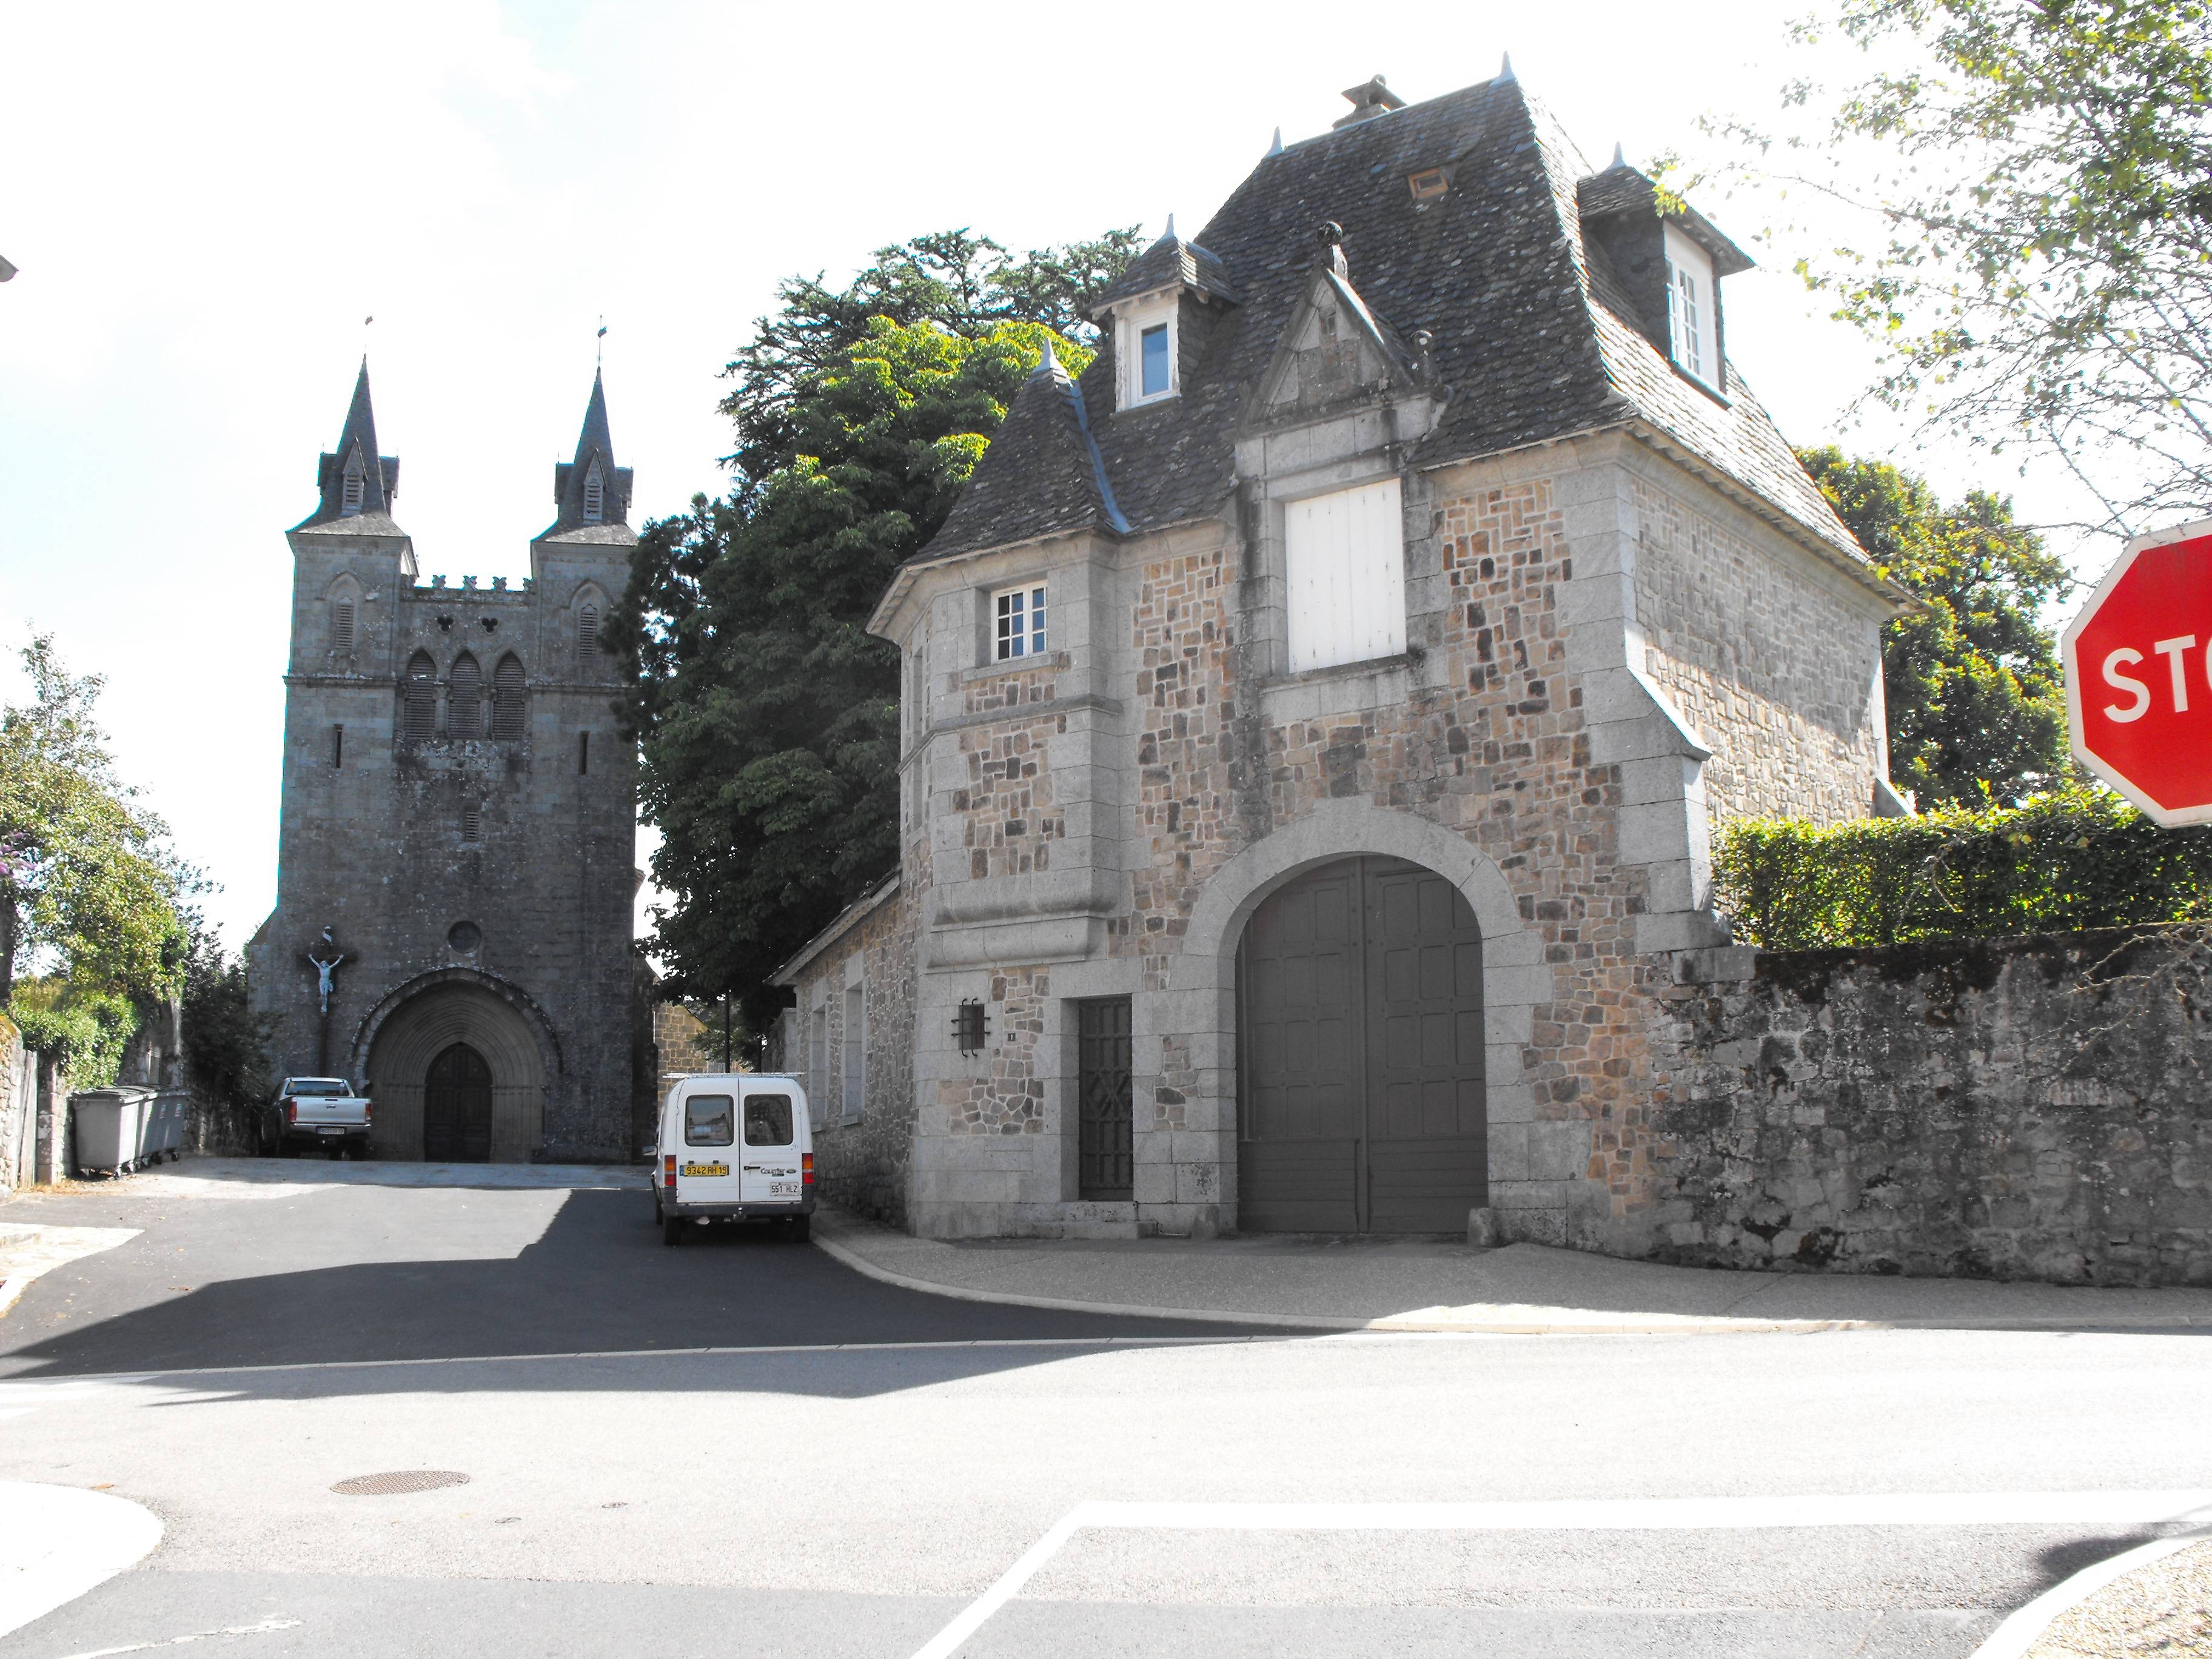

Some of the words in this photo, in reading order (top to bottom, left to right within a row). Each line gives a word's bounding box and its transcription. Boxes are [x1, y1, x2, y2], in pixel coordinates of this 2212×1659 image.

[2102, 634, 2212, 723] ST
[686, 1166, 706, 1175] 9342
[719, 1166, 727, 1175] 19
